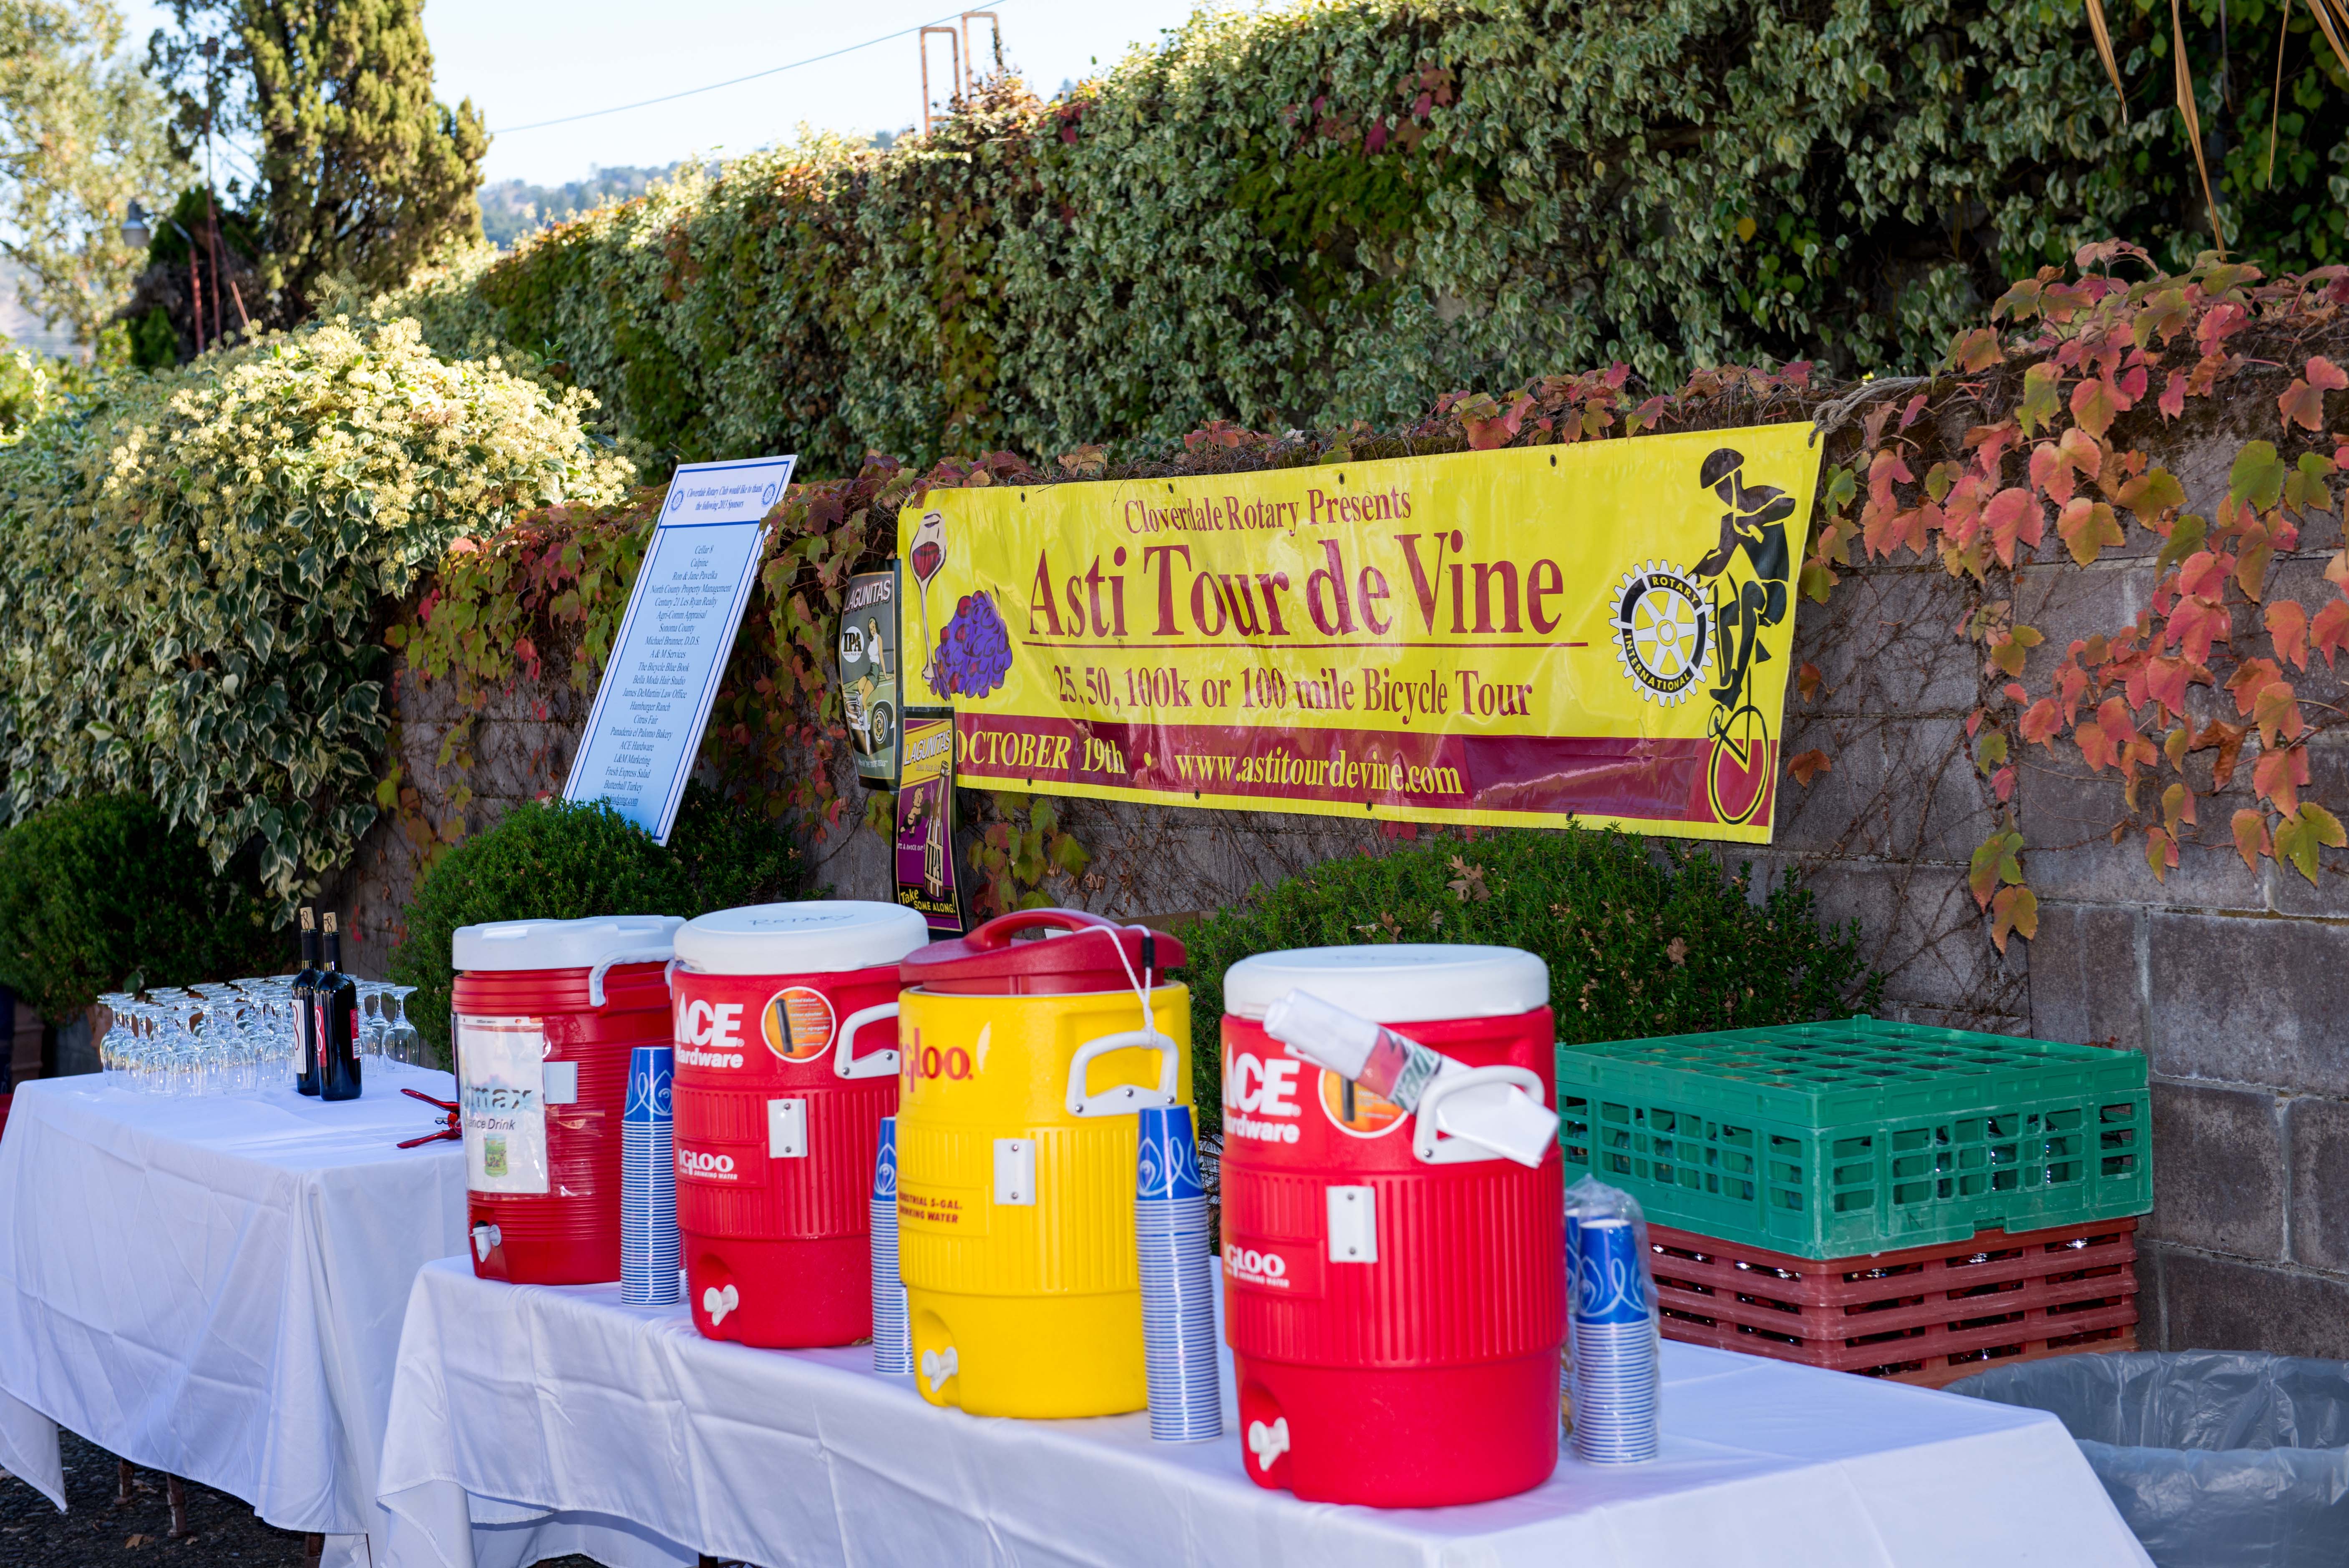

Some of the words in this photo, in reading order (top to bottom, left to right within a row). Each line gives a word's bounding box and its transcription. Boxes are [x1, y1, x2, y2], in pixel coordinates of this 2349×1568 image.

[687, 488, 706, 498] Cloverdale
[706, 487, 719, 498] Rotary
[719, 486, 729, 496] Club
[729, 485, 740, 495] would
[751, 483, 763, 493] thank
[702, 500, 719, 511] following
[718, 500, 728, 509] 2013
[728, 499, 744, 511] Sponsors
[1124, 497, 1224, 534] Cloverdale
[1223, 495, 1299, 537] Rotary
[1307, 485, 1412, 526] Presents
[695, 545, 709, 554] Cellar
[710, 545, 714, 554] 8
[690, 558, 709, 569] Calpine
[672, 571, 682, 581] Ron
[682, 571, 688, 580] &
[687, 571, 699, 580] Jane
[699, 571, 718, 580] Pavelka
[650, 585, 665, 594] North
[664, 584, 682, 595] County
[681, 584, 702, 595] Property
[702, 584, 732, 594] Management
[1029, 546, 1128, 638] Asti
[1143, 544, 1291, 637] Tour
[1307, 539, 1393, 637] de
[1394, 529, 1563, 636] Vine
[1652, 576, 1699, 603] ROTARY
[655, 597, 673, 608] Century
[673, 597, 680, 606] 21
[689, 597, 703, 608] Ryan
[702, 596, 718, 608] Realty
[844, 579, 891, 613] LAGUNITAS
[656, 610, 685, 621] Agri-Comm
[684, 610, 708, 621] Appraisal
[659, 623, 677, 632] Sonoma
[678, 623, 695, 634] County
[645, 636, 664, 645] Michael
[664, 636, 683, 646] Brunner,
[684, 636, 700, 645] D.D.S.
[843, 632, 862, 652] IPA
[650, 649, 655, 658] A
[655, 649, 660, 658] &
[660, 649, 667, 658] M
[667, 649, 687, 659] Services
[638, 662, 648, 671] The
[647, 662, 665, 674] Bicycle
[665, 662, 677, 672] Blue
[677, 662, 690, 672] Book
[1624, 634, 1690, 691] INTERNATIONAL
[632, 675, 645, 684] Bella
[645, 675, 659, 685] Moda
[659, 676, 670, 685] Hair
[670, 676, 686, 685] Studio
[622, 688, 637, 697] James
[637, 688, 661, 698] DeMartini
[660, 689, 672, 698] Law
[672, 689, 687, 699] Office
[1201, 678, 1231, 707] or
[1240, 667, 1287, 709] 100
[1293, 667, 1355, 711] mile
[1361, 667, 1448, 725] Bicycle
[1455, 669, 1533, 717] Tour
[630, 701, 656, 713] Hamburger
[655, 702, 671, 711] Ranch
[634, 714, 648, 724] Citrus
[647, 715, 659, 725] Fair
[610, 727, 633, 737] Panaderia
[632, 728, 638, 737] el
[637, 728, 656, 738] Palomo
[656, 729, 673, 741] Bakery
[619, 740, 632, 750] ACE
[632, 741, 654, 751] Hardware
[904, 728, 951, 766] LAGUNITAS
[957, 730, 1071, 770] OCTOBER
[1080, 738, 1126, 774] 19th
[614, 753, 628, 763] L&M
[627, 754, 651, 767] Marketing
[605, 766, 619, 776] Fresh
[619, 767, 637, 779] Express
[637, 768, 651, 778] Salad
[1174, 746, 1465, 794] www.astitourdevine.com
[604, 779, 627, 790] Butterball
[627, 781, 644, 794] Turkey
[926, 842, 942, 881] IPA
[900, 888, 919, 904] Take
[914, 900, 931, 911] SOME
[933, 892, 956, 913] ALONG!
[675, 992, 744, 1047] ACE
[315, 1009, 323, 1052] 8
[675, 1043, 744, 1068] Hardware
[488, 1118, 516, 1130] Drink
[679, 1148, 734, 1175] IGLOO
[927, 1211, 959, 1223] WATER
